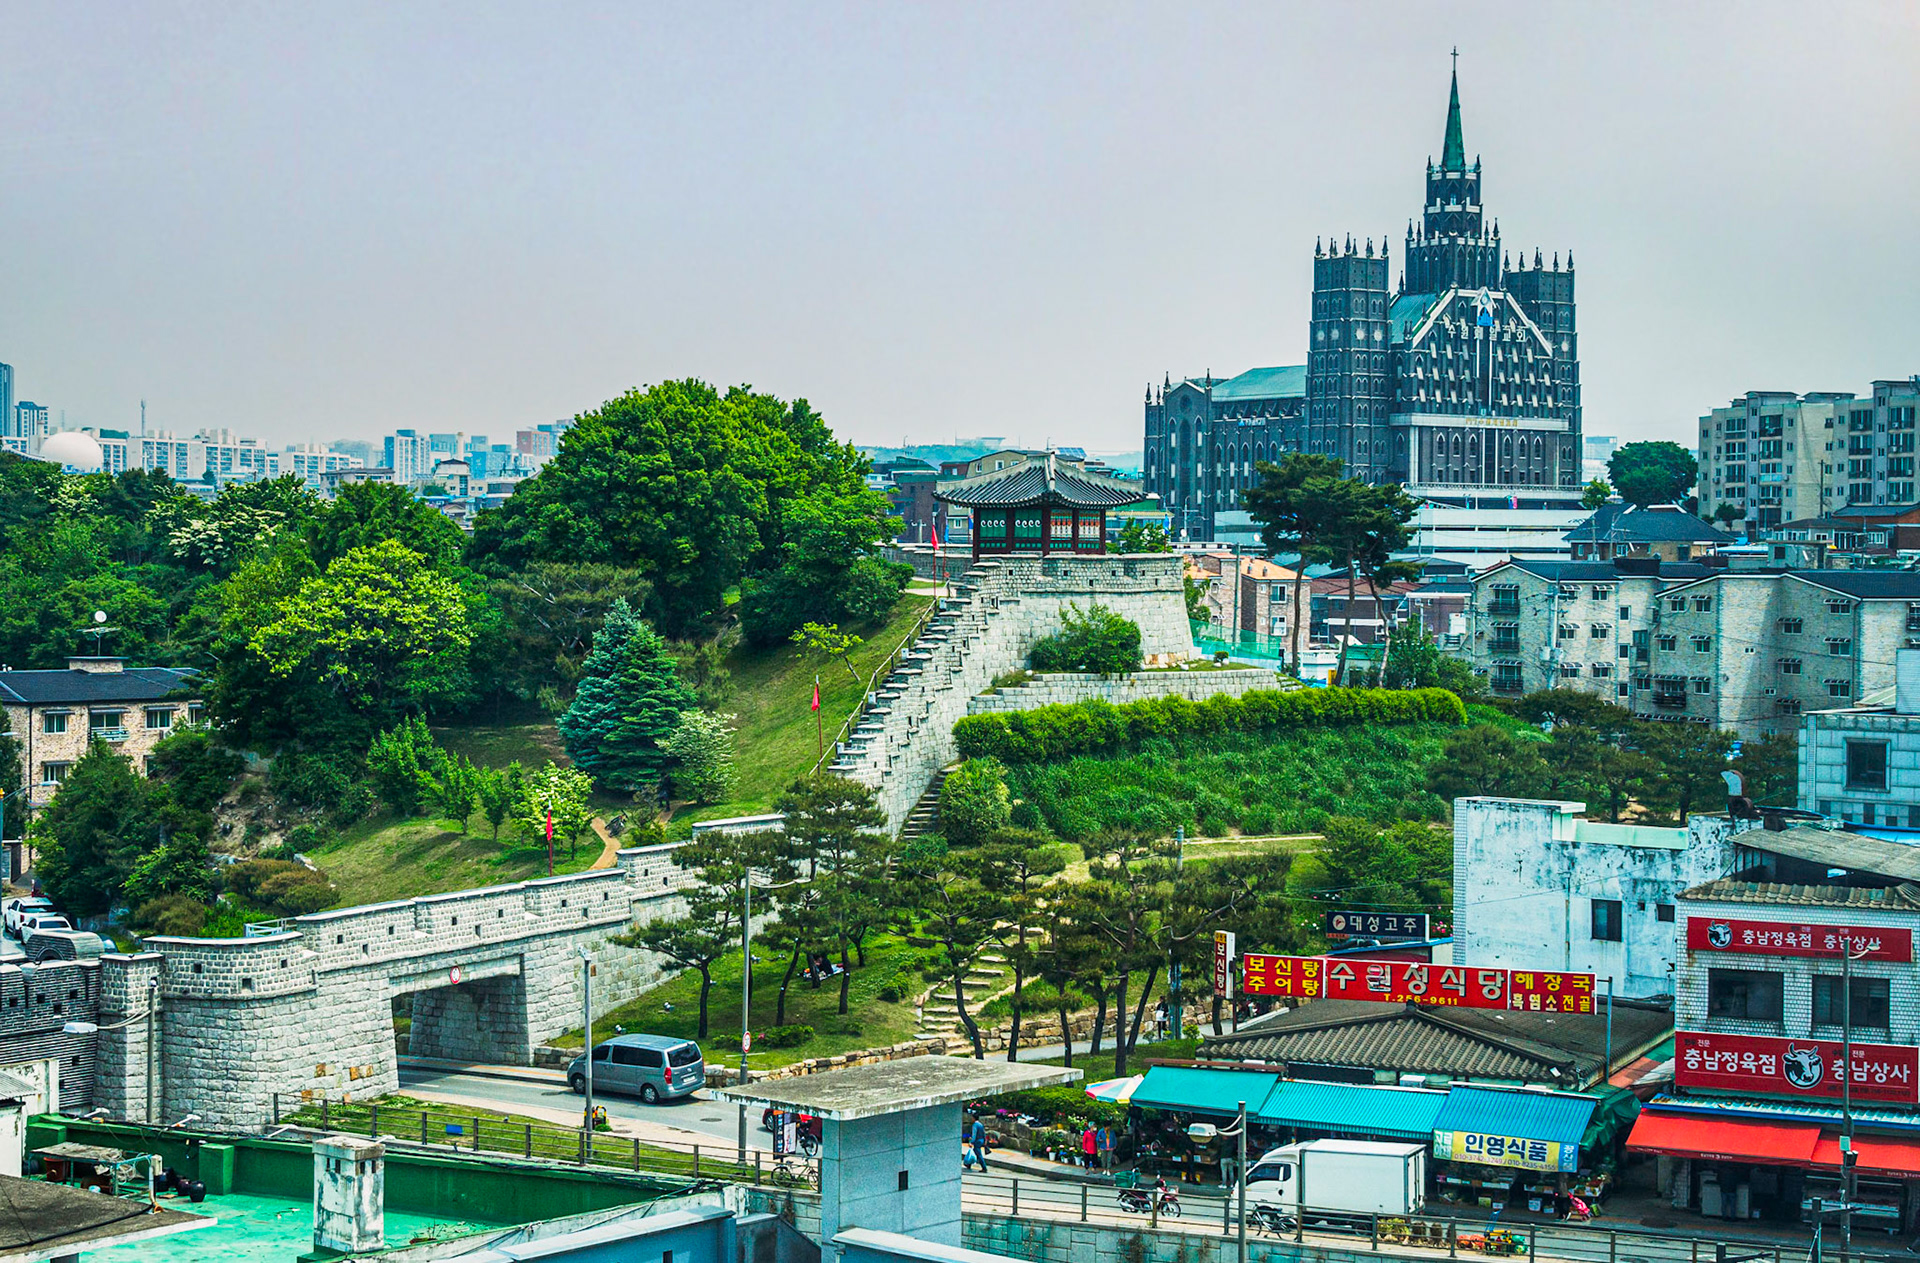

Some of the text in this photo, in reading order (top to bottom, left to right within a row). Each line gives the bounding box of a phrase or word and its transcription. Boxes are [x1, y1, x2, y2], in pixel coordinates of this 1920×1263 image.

[1350, 915, 1417, 933] 대성고추
[1742, 929, 1811, 948] 충남정육점
[1216, 942, 1225, 988] 보신탕
[1248, 957, 1320, 978] 보신탕
[1248, 975, 1320, 996] 추어탕
[1330, 962, 1506, 1000] 수원성식당
[1514, 973, 1591, 992] 해장국
[1384, 993, 1458, 1006] T.256-9611
[1683, 1048, 1911, 1083] 충남정육점 충남상사
[1465, 1134, 1548, 1163] 인영식품
